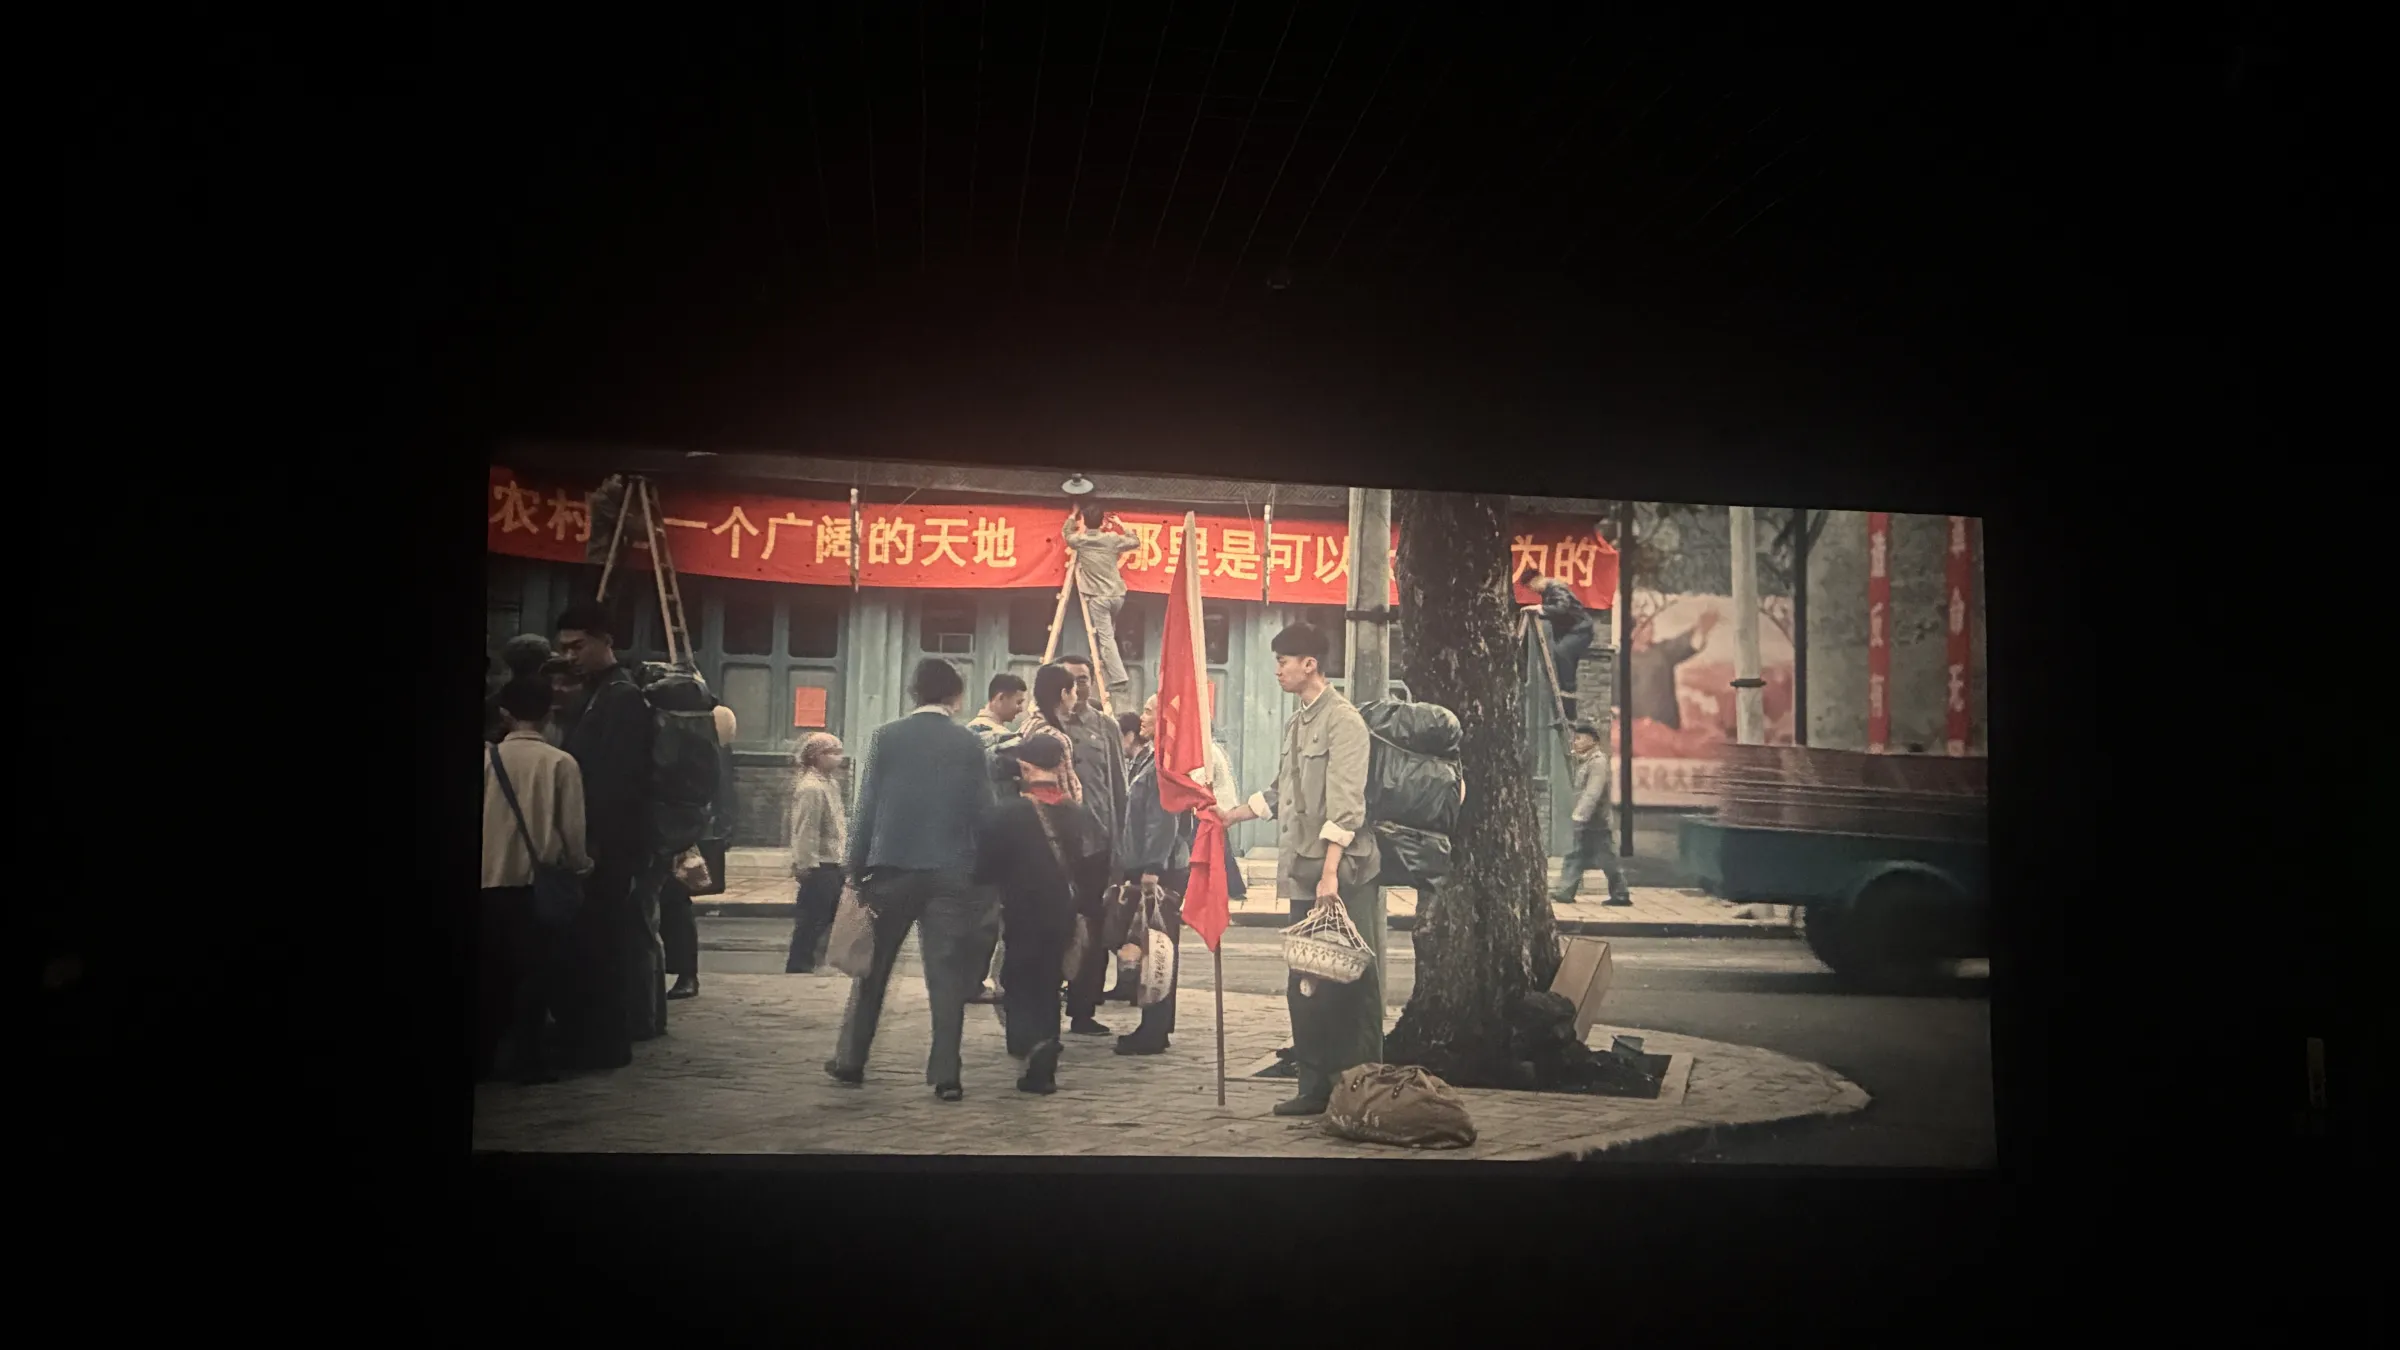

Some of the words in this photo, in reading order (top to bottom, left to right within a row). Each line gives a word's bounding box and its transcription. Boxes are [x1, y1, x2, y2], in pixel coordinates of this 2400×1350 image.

[489, 479, 1017, 568] 农村一个广阔的天地
